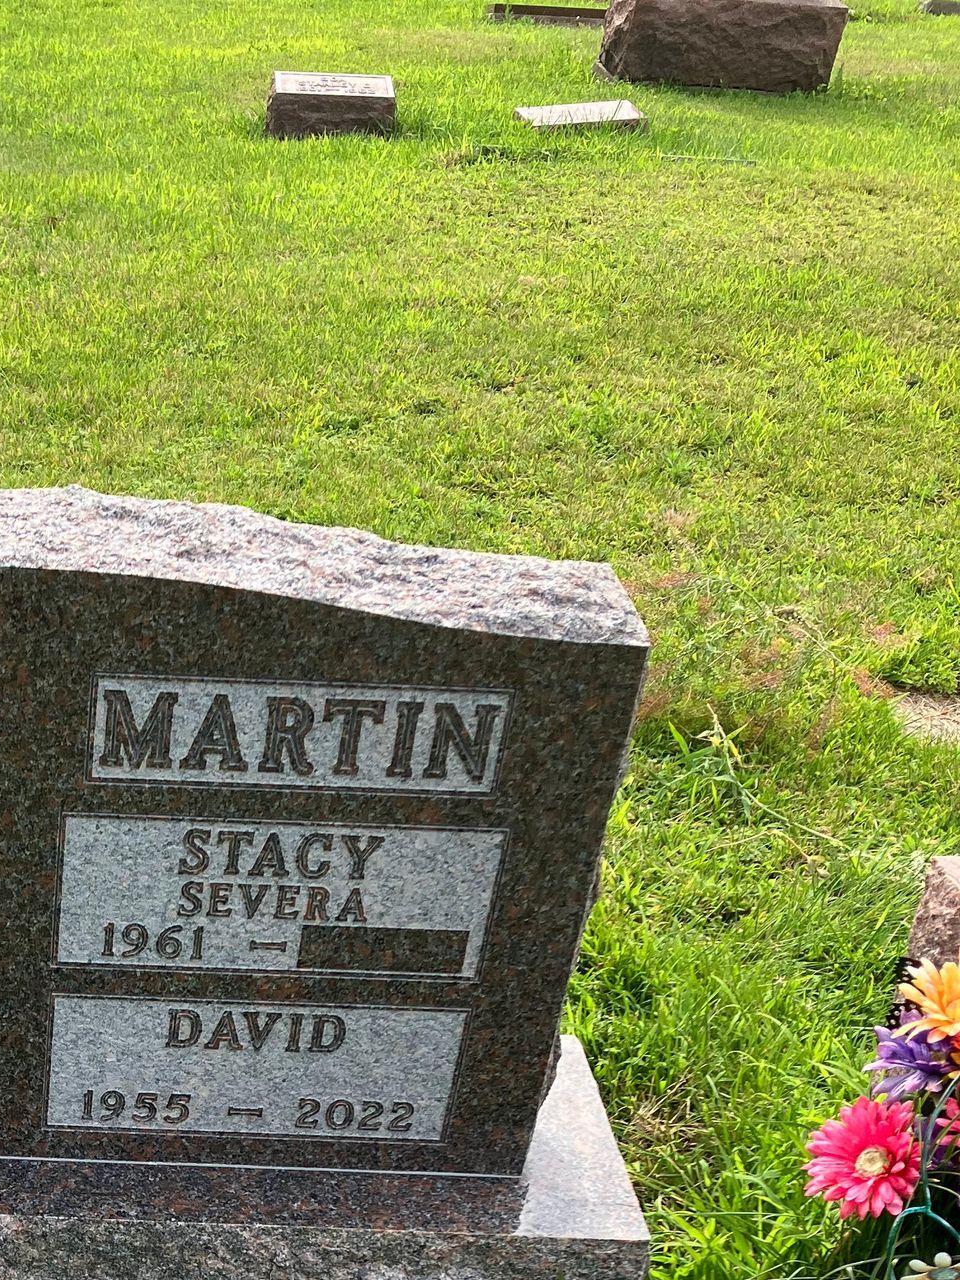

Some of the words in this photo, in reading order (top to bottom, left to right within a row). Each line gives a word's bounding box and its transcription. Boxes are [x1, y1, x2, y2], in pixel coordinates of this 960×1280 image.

[98, 688, 502, 783] MARTIN
[177, 828, 385, 880] STACY
[176, 881, 368, 923] SEVERA
[100, 922, 204, 960] 1961
[165, 1008, 347, 1053] DAVID
[81, 1089, 192, 1124] 1955
[295, 1098, 415, 1132] 2022
